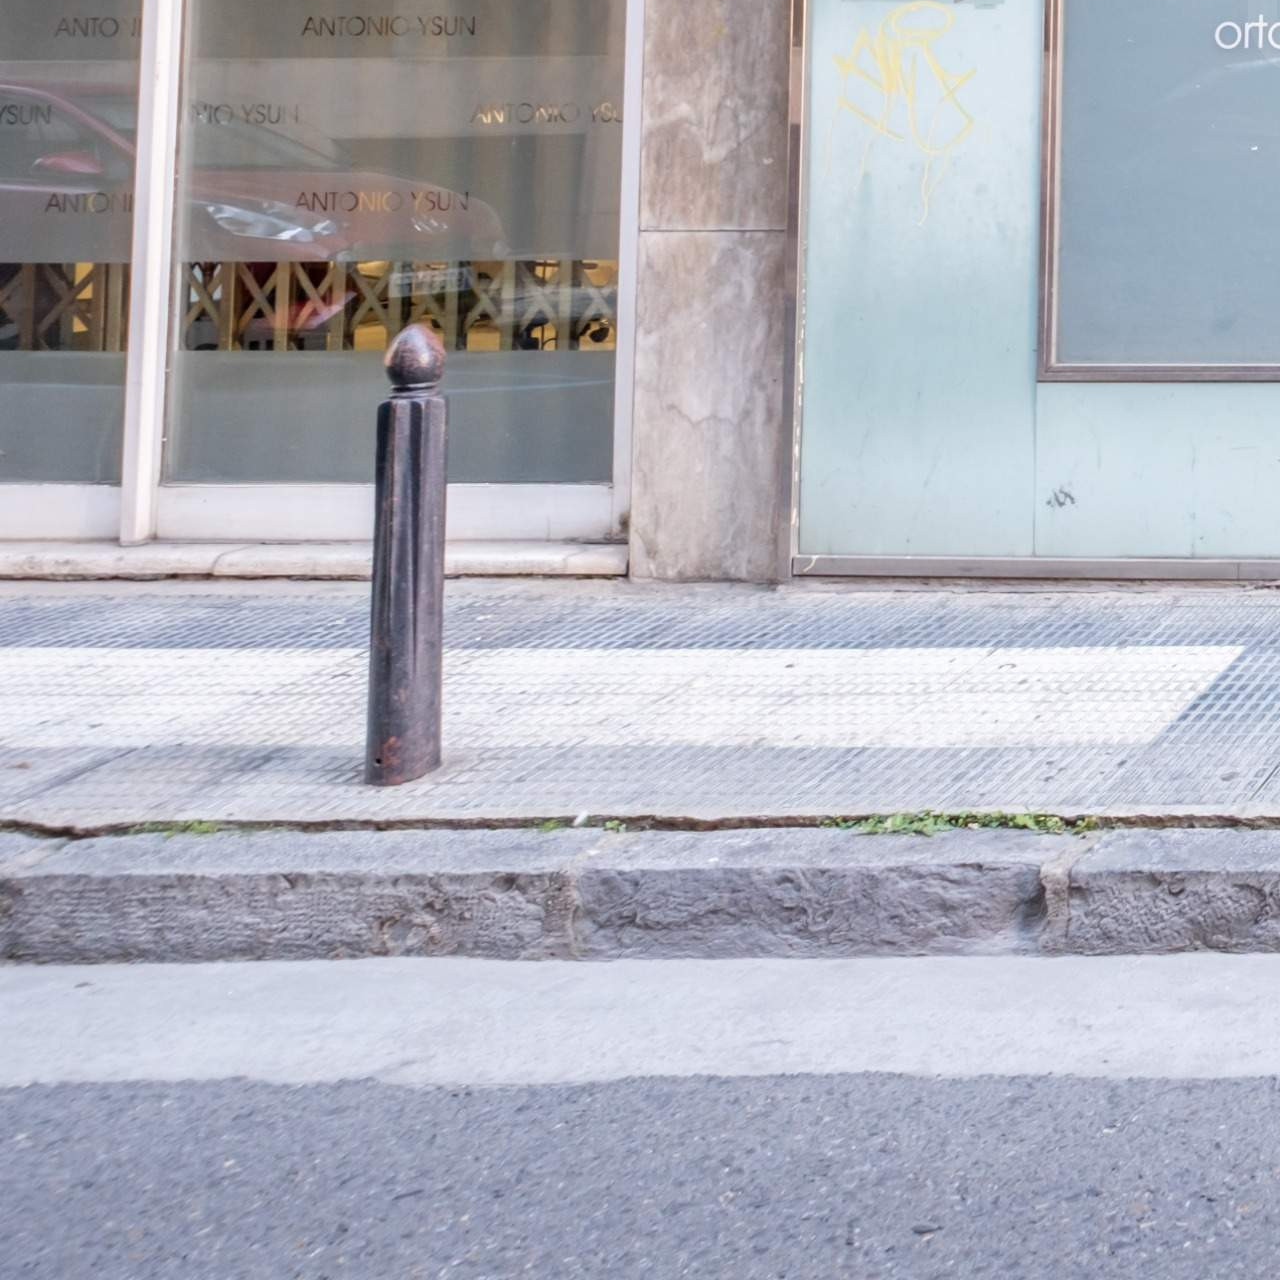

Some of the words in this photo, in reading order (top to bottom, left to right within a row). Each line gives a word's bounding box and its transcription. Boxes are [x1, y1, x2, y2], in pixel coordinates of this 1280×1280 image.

[301, 16, 406, 37] ANTONIO
[416, 16, 477, 37] YSUN
[295, 190, 403, 212] ANTONIO
[410, 191, 470, 212] YSUN
